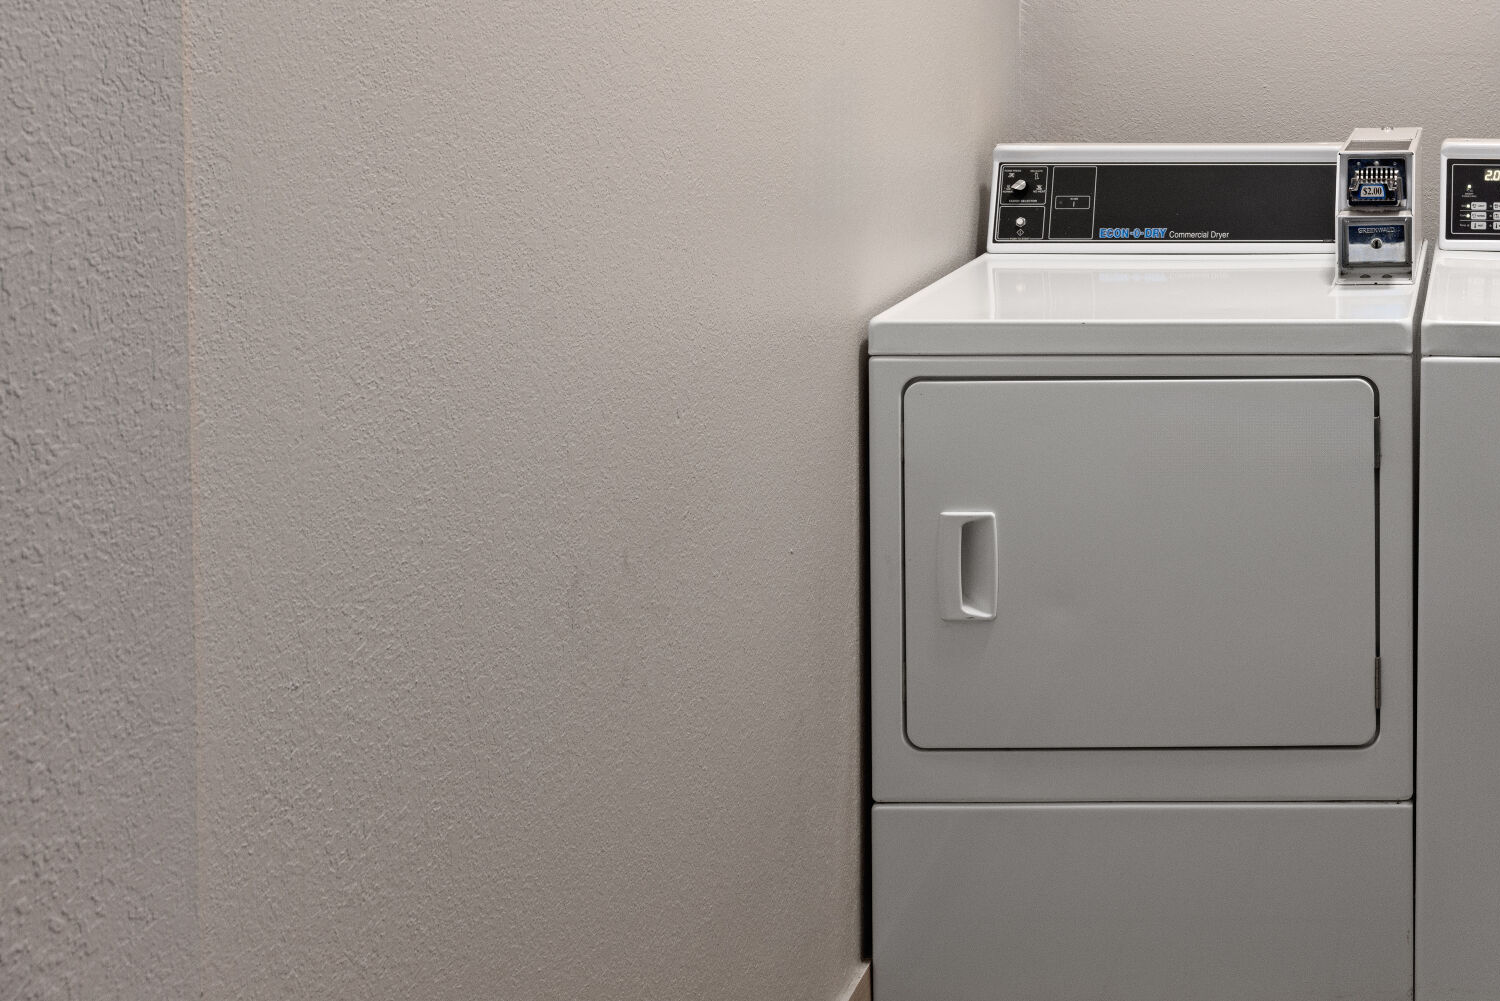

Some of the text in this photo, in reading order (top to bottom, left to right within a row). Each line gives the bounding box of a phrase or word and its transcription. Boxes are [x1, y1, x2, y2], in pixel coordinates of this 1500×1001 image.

[1362, 185, 1382, 197] $2.00
[1099, 227, 1229, 240] ECON-O-DRY Commercial Dryer
